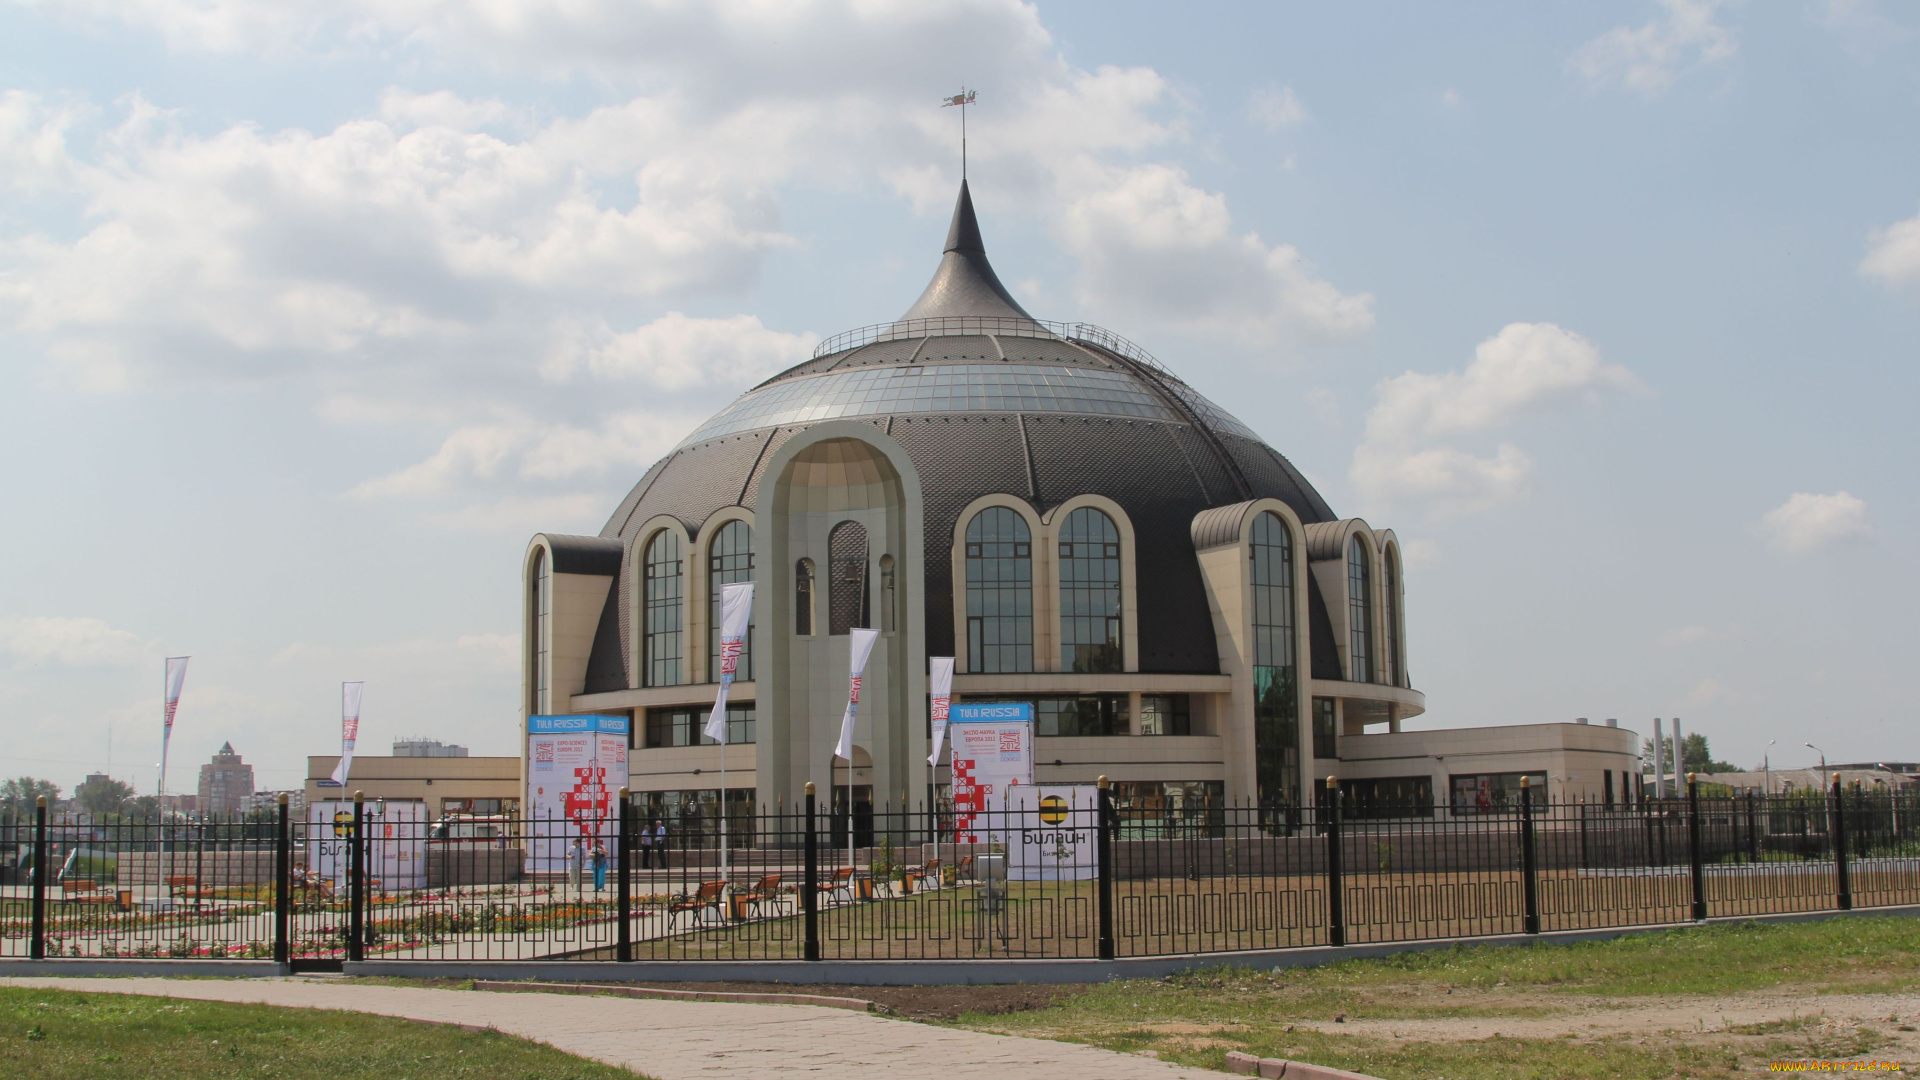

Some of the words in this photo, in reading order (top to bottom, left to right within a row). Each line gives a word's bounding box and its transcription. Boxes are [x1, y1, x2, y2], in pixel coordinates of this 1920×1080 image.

[959, 708, 979, 718] TULA
[980, 707, 1020, 718] RUSSIA
[536, 720, 552, 728] TULA
[554, 719, 587, 728] RUSSIA
[999, 742, 1021, 750] 2012
[536, 752, 554, 760] 2012
